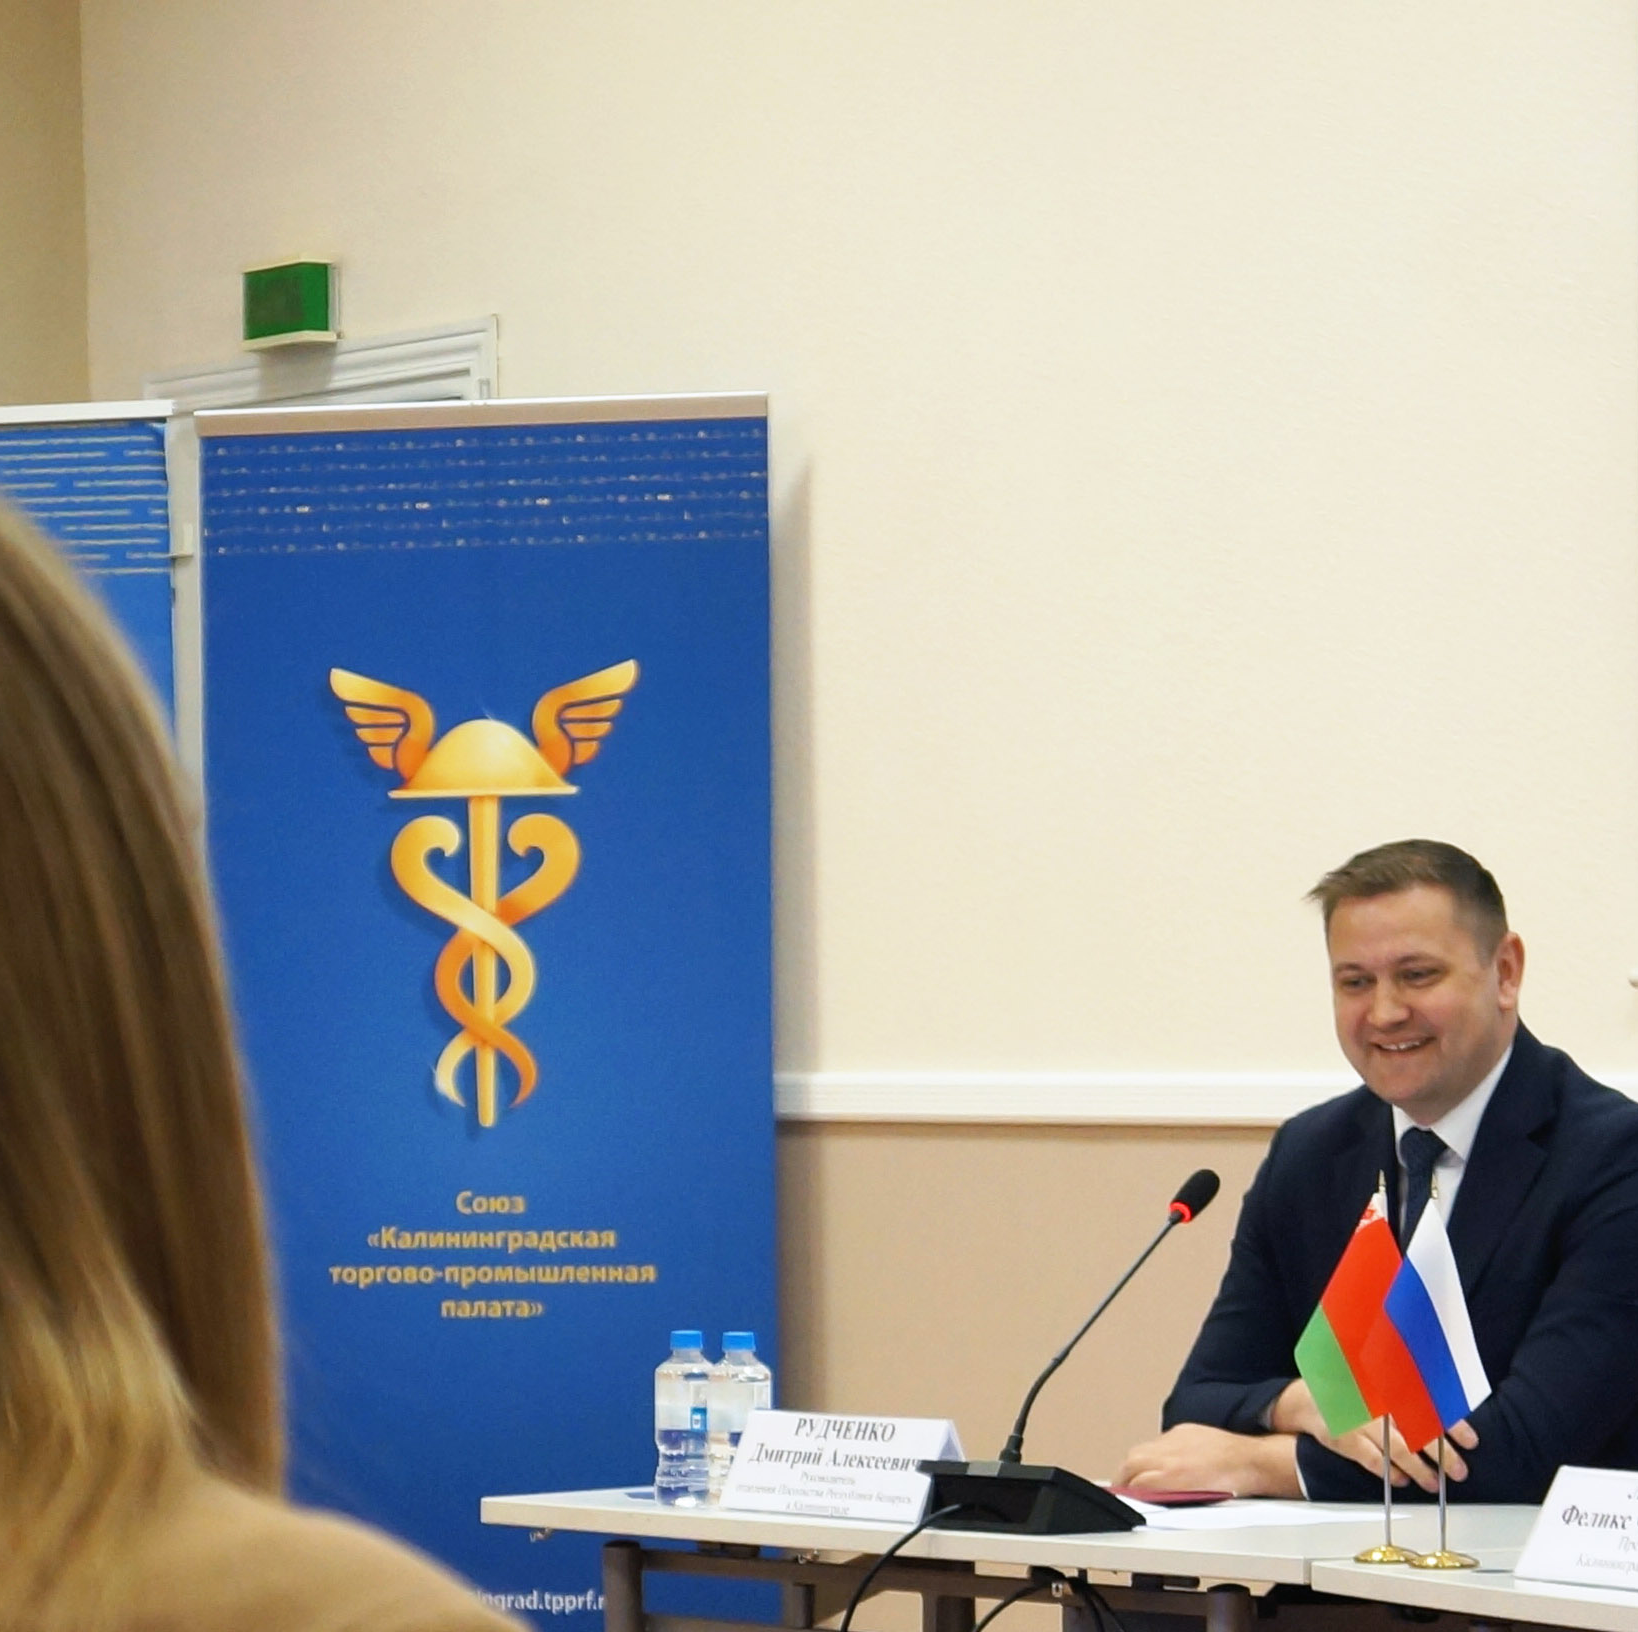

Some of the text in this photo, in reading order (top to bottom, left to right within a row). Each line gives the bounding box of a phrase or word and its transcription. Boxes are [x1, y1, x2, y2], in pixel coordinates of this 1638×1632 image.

[456, 1190, 526, 1215] Союз
[366, 1226, 617, 1253] «Калининградская
[329, 1265, 658, 1289] торгово-промышленная
[440, 1299, 545, 1319] палата»
[795, 1417, 896, 1443] РУДЧЕНКО
[748, 1442, 919, 1472] Дмитрий Алексеевич
[1562, 1504, 1633, 1530] Феликс
